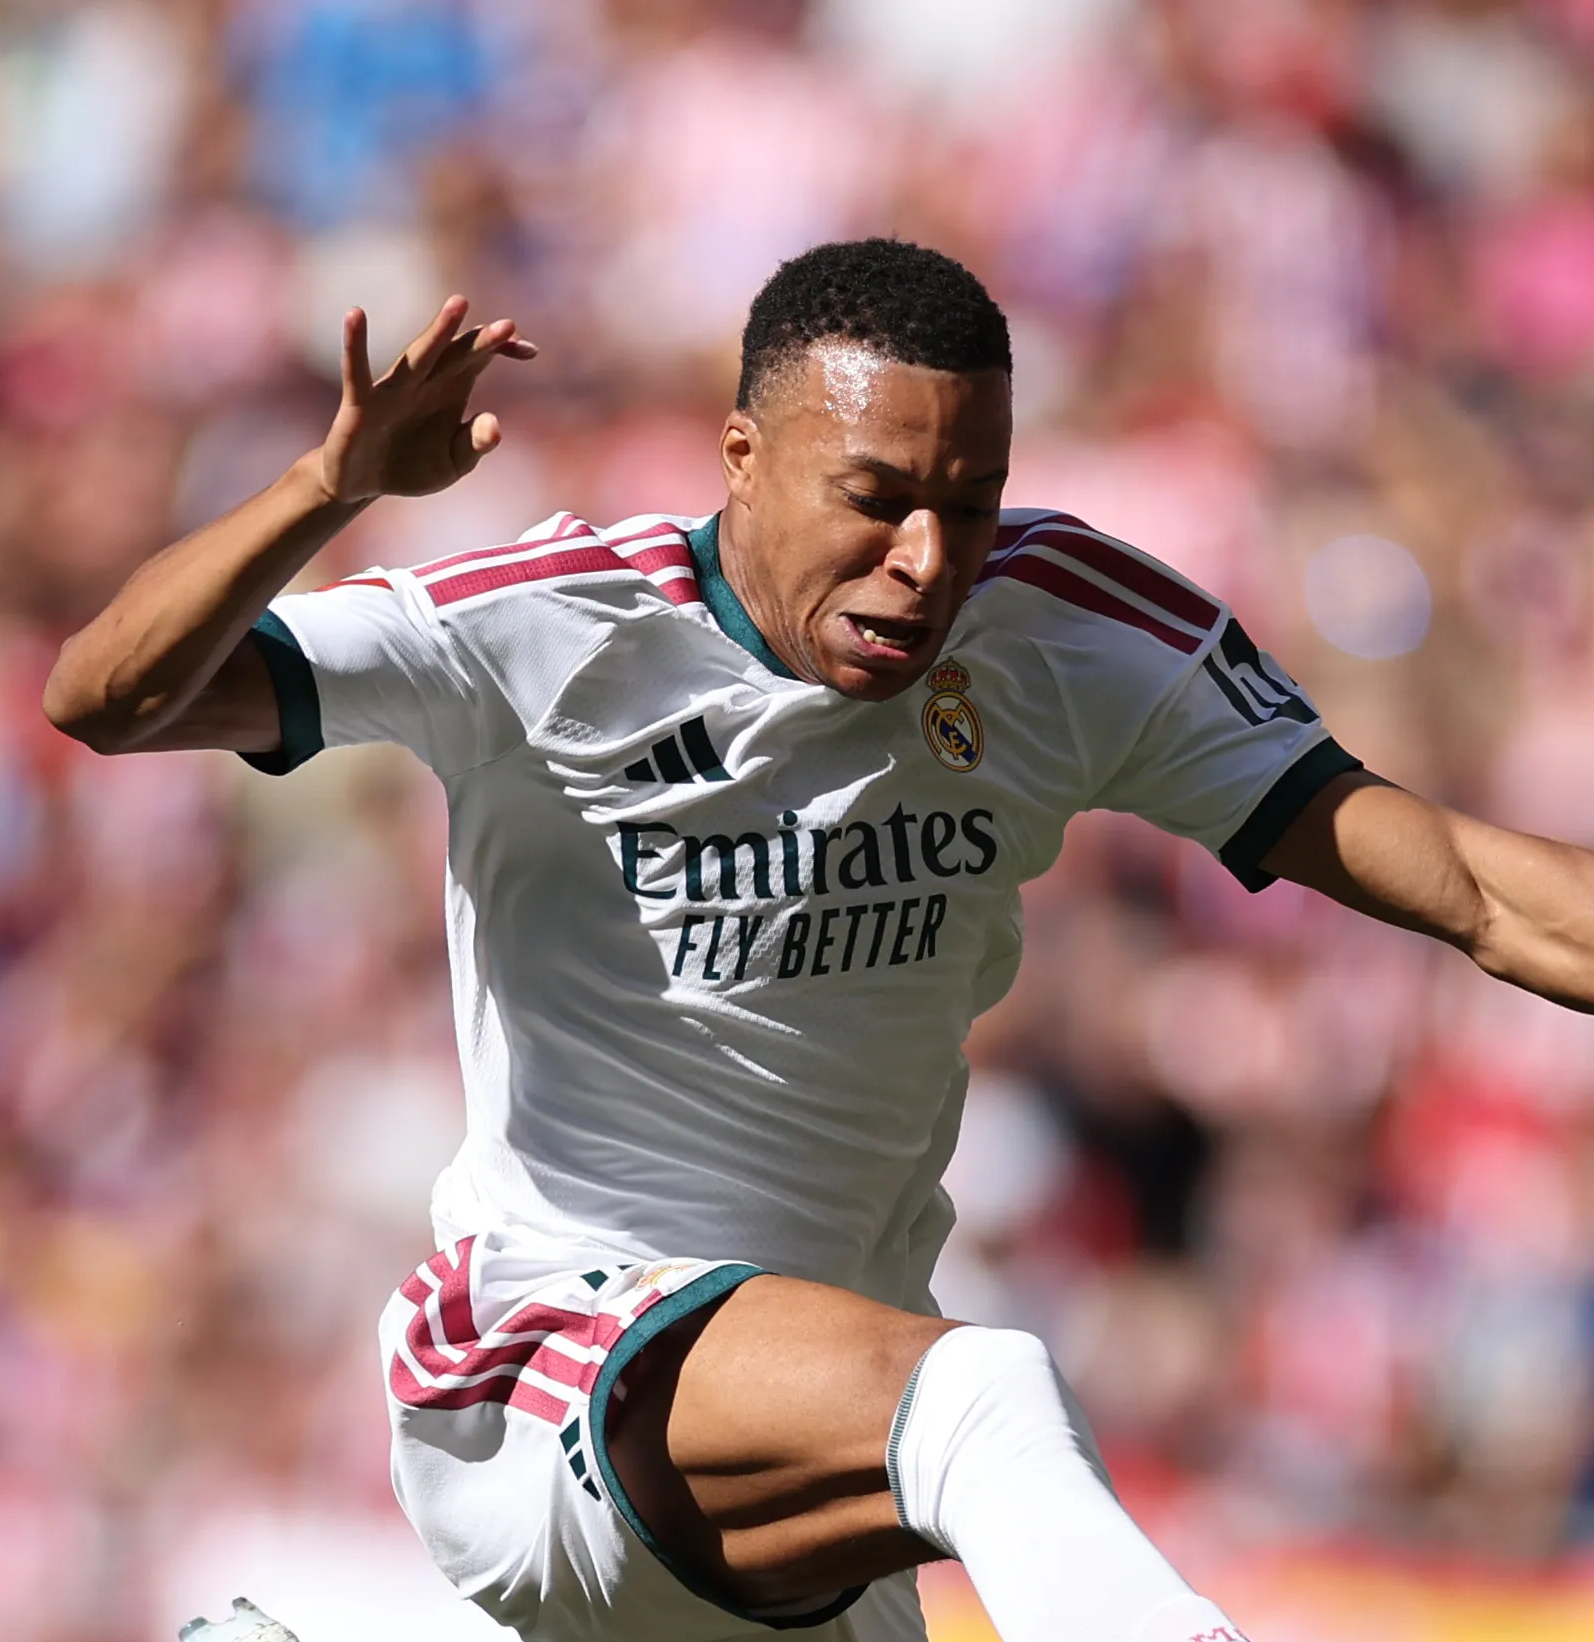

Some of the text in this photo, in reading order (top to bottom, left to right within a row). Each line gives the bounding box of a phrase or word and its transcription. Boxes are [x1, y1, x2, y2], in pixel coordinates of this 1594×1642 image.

[616, 801, 998, 902] Emirates
[672, 893, 948, 982] FLY BETTER
